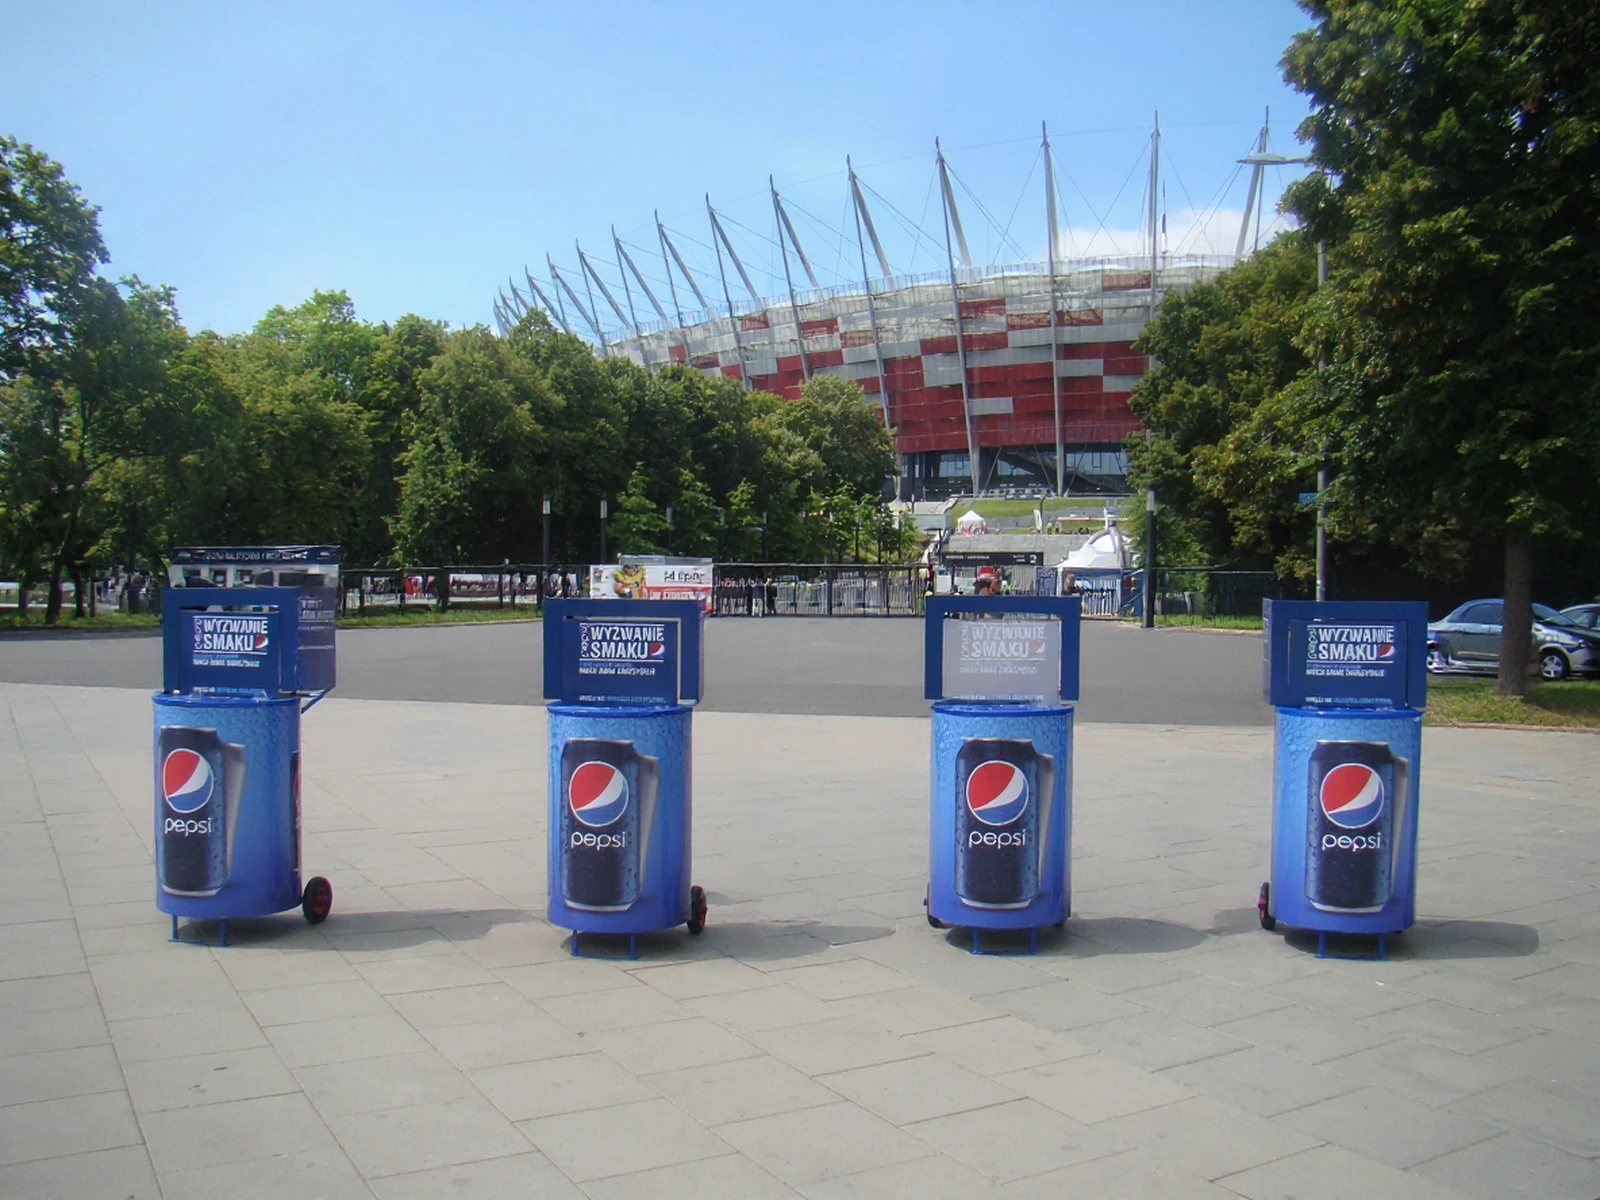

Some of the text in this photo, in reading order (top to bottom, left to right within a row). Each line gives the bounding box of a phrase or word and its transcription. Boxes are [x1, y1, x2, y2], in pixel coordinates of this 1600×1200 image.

[203, 633, 254, 651] SMAKU
[590, 641, 649, 659] SMAKU
[971, 640, 1029, 658] SMAKU
[1318, 643, 1377, 661] SMAKU
[164, 817, 212, 837] pepsi
[571, 831, 626, 851] pepsi
[968, 829, 1026, 850] pepsi
[1321, 831, 1382, 852] pepsi
